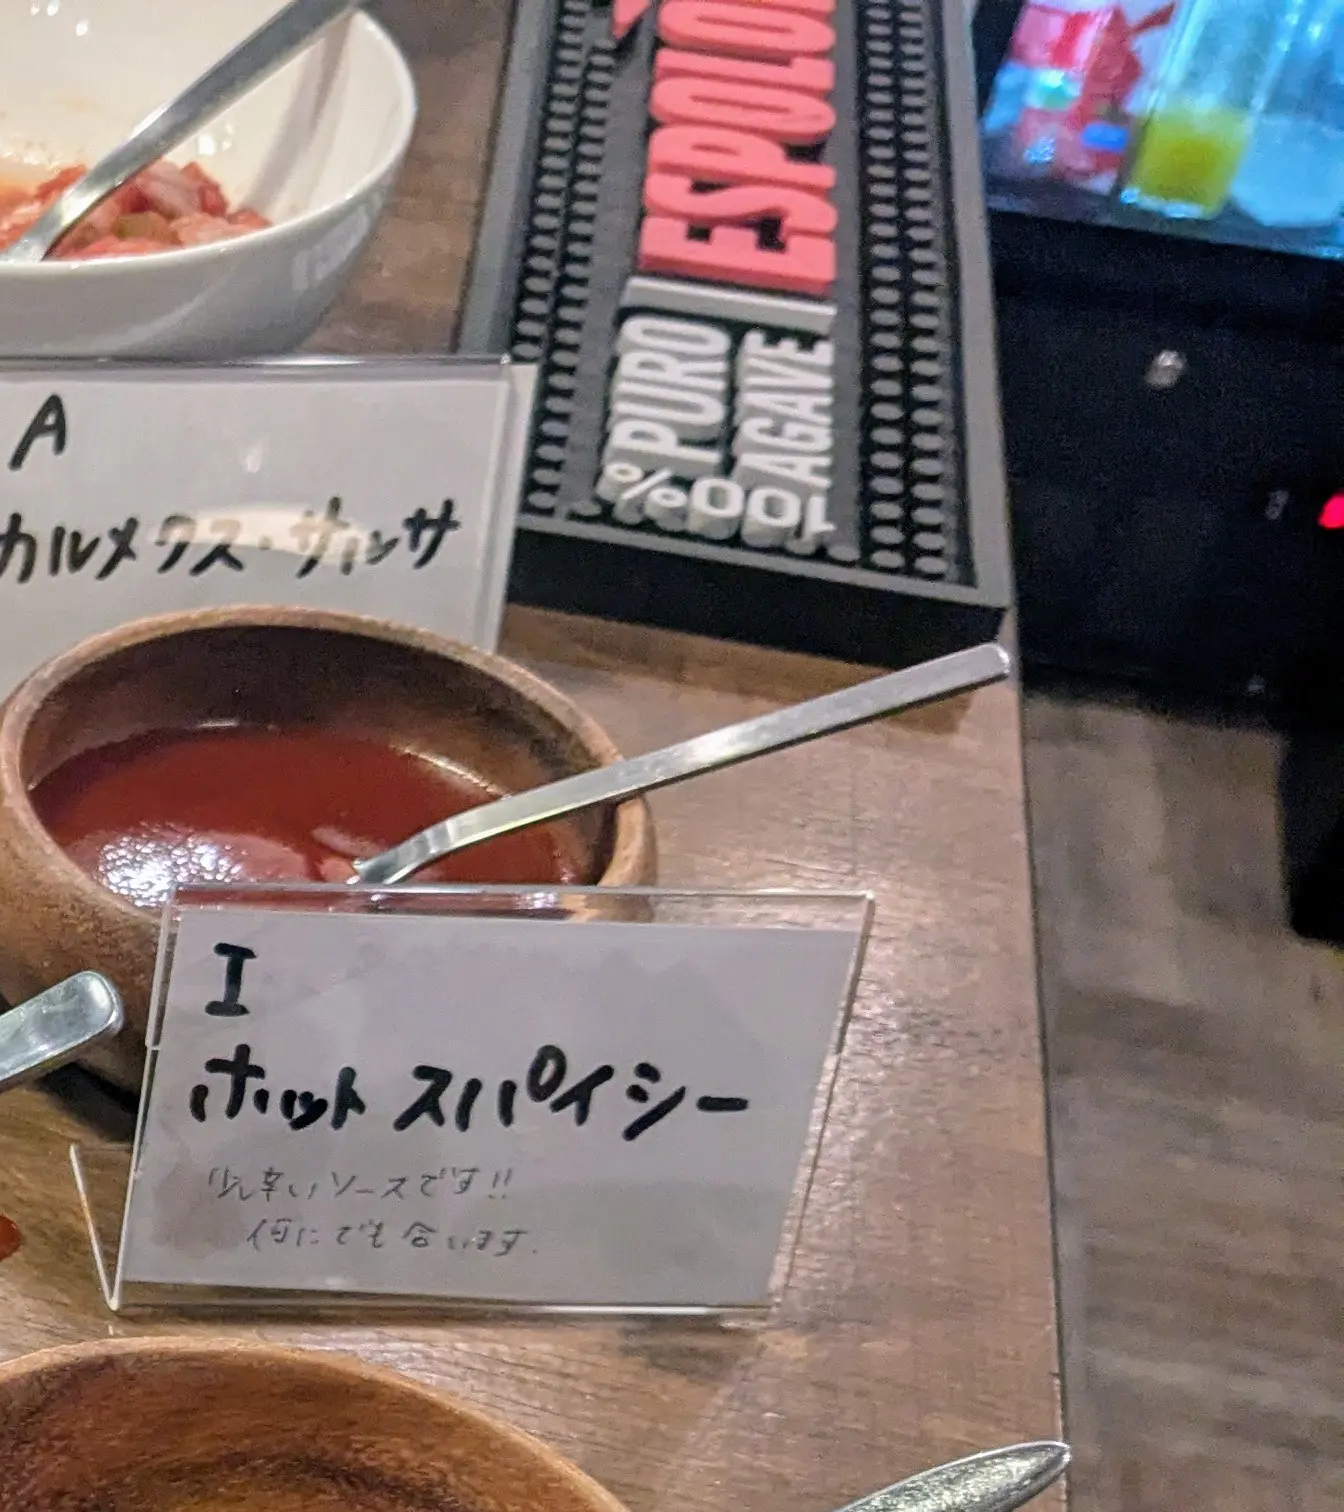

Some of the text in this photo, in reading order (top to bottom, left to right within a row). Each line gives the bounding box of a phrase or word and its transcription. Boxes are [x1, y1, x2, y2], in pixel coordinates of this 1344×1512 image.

[610, 315, 732, 465] PURO
[736, 328, 835, 491] AGAVE
[9, 393, 68, 471] A
[604, 461, 838, 533] 100%
[203, 941, 258, 1018] I
